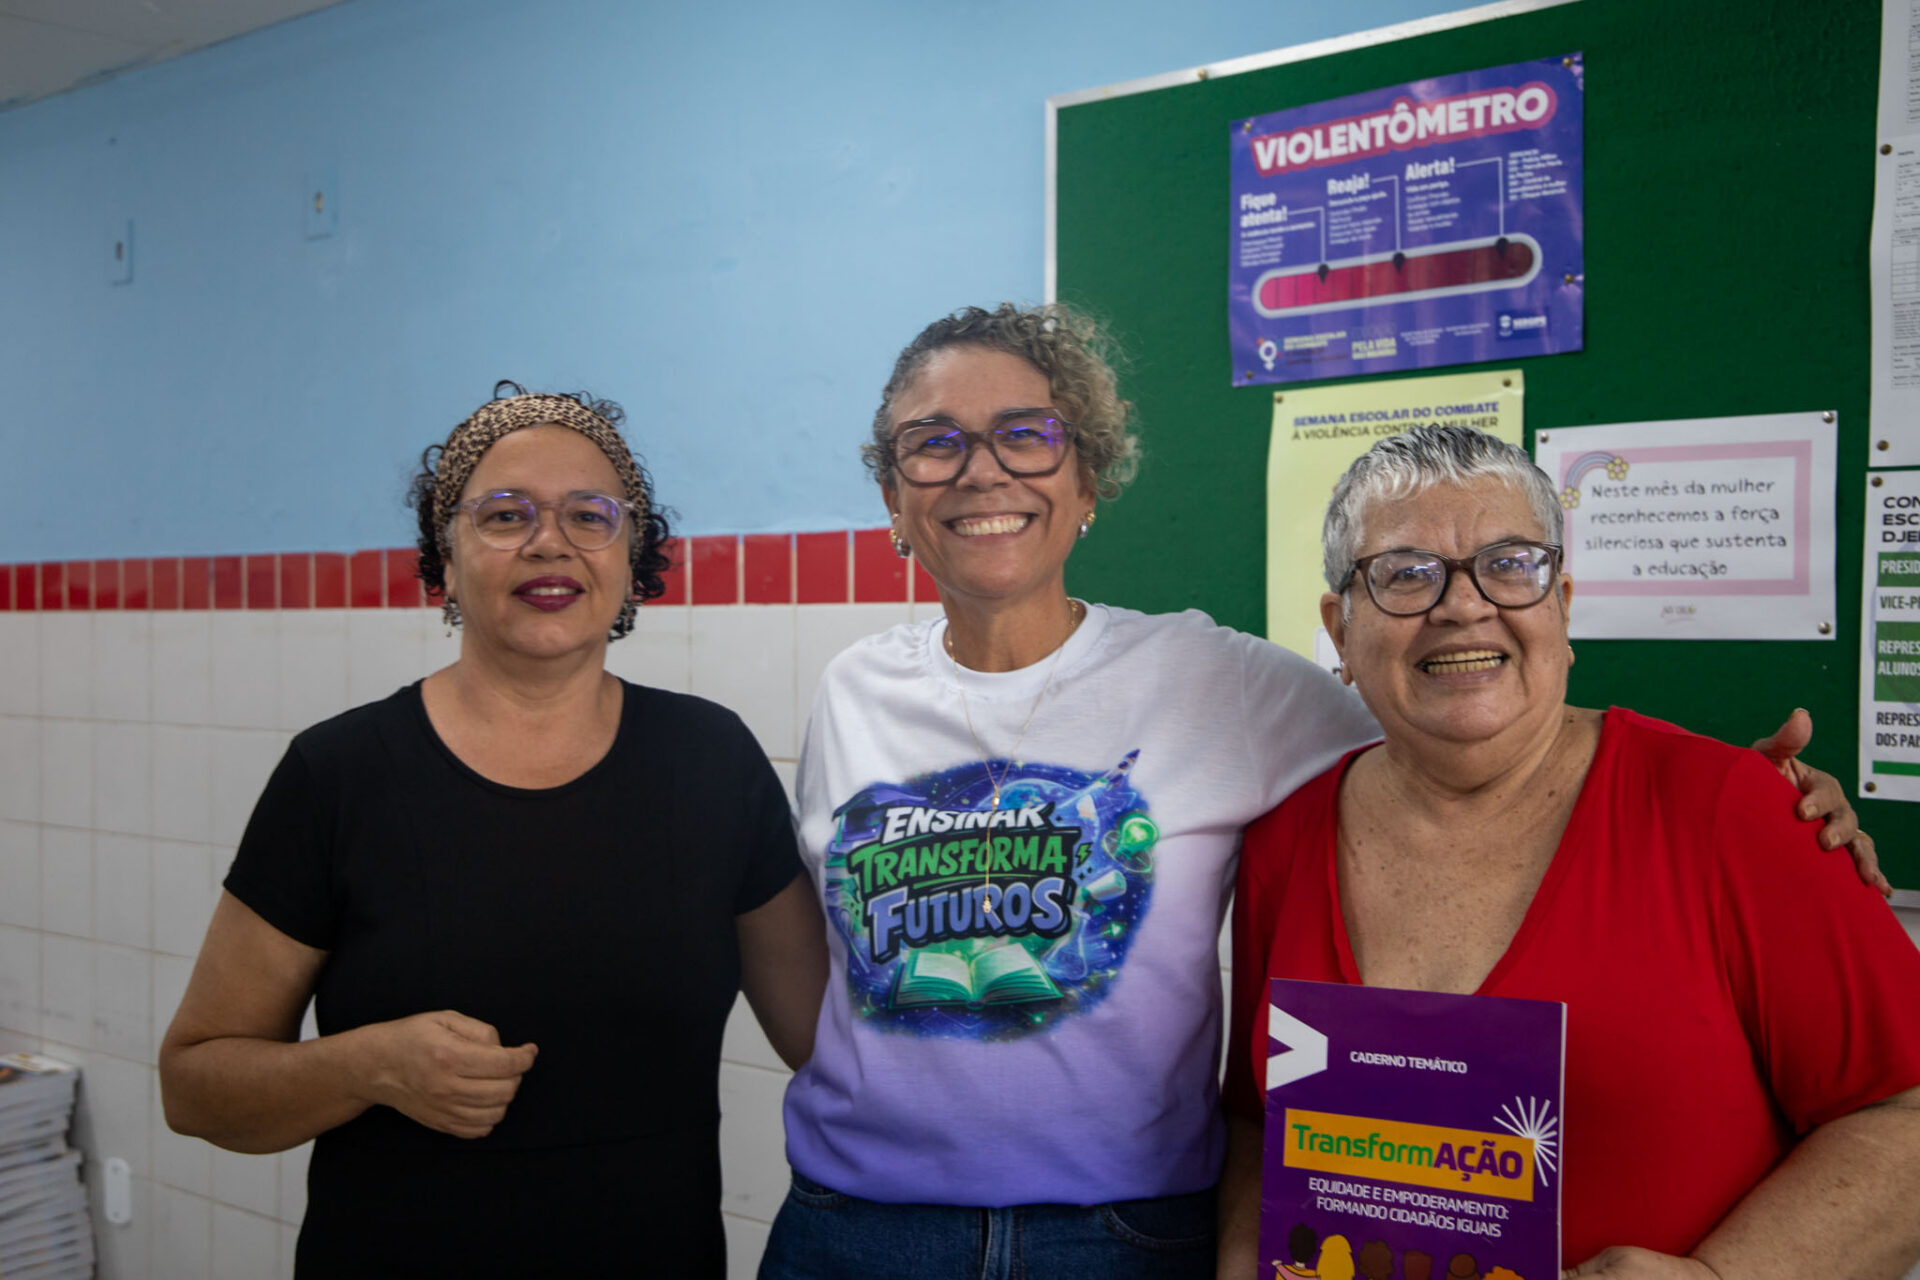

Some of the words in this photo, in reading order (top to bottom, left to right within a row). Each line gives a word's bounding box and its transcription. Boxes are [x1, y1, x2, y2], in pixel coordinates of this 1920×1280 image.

[1254, 87, 1549, 170] VIOLENTÔMETRO
[1405, 157, 1455, 181] Alerta!
[1327, 172, 1370, 195] Reaja!
[1241, 192, 1277, 211] Fique
[1241, 205, 1288, 228] atenta!
[1293, 413, 1346, 426] SEMANA
[1350, 409, 1409, 423] ESCOLAR
[1412, 407, 1431, 418] DO
[1434, 402, 1498, 416] COMBATE
[1304, 424, 1370, 440] VIOLÊNCIA
[1591, 484, 1640, 498] Neste
[1645, 480, 1678, 496] mês
[1685, 481, 1705, 495] da
[1711, 478, 1774, 494] mulher
[1590, 509, 1709, 524] reconhecemos
[1714, 511, 1725, 521] a
[1732, 505, 1780, 523] força
[1883, 513, 1919, 526] ESC
[1585, 536, 1664, 551] silenciosa
[1669, 538, 1699, 552] que
[1706, 533, 1787, 549] sustenta
[1882, 530, 1920, 543] DJE
[1632, 564, 1642, 576] a
[1648, 560, 1728, 579] educação
[1876, 732, 1898, 747] DOS
[1900, 734, 1920, 748] PAI
[882, 802, 1049, 845] ENSINAR
[850, 835, 1068, 893] TRANSFORMA
[867, 877, 1065, 956] FUTUROS
[1350, 1051, 1406, 1068] CADERNO
[1407, 1056, 1468, 1074] TEMÁTICO
[1292, 1123, 1523, 1182] TransformAÇÃO
[1308, 1177, 1371, 1199] EQUIDADE
[1372, 1187, 1382, 1199] E
[1383, 1188, 1509, 1220] EMPODERAMENTO:
[1316, 1197, 1387, 1220] FORMANDO
[1389, 1207, 1455, 1230] CIDADÃOS
[1456, 1218, 1502, 1237] IGUAIS
